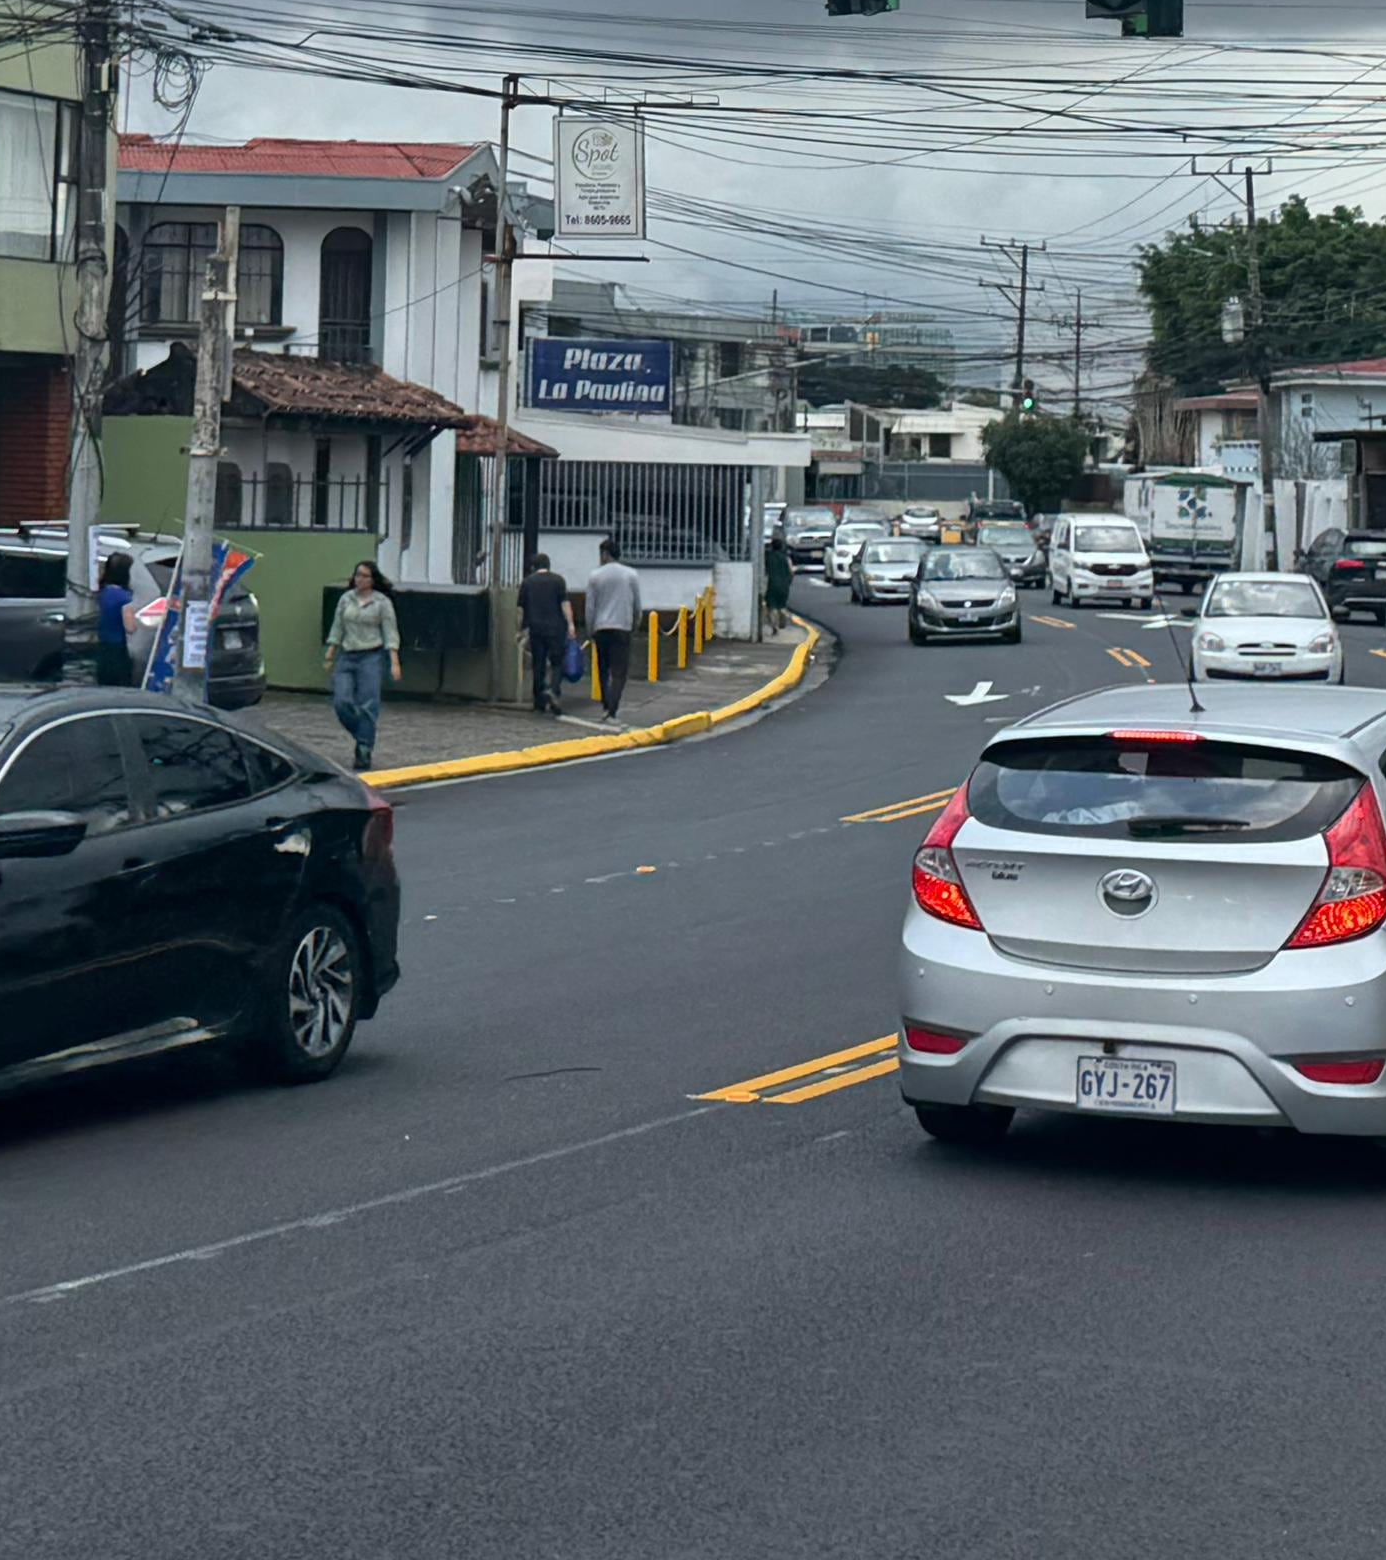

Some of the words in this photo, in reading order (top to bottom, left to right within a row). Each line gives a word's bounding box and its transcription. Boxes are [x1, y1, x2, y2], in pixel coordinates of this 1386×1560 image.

[575, 138, 620, 169] Spot
[563, 347, 643, 371] Plaza
[538, 378, 569, 400] La
[574, 379, 666, 402] Paulina
[1081, 1070, 1171, 1102] GYJ-267
